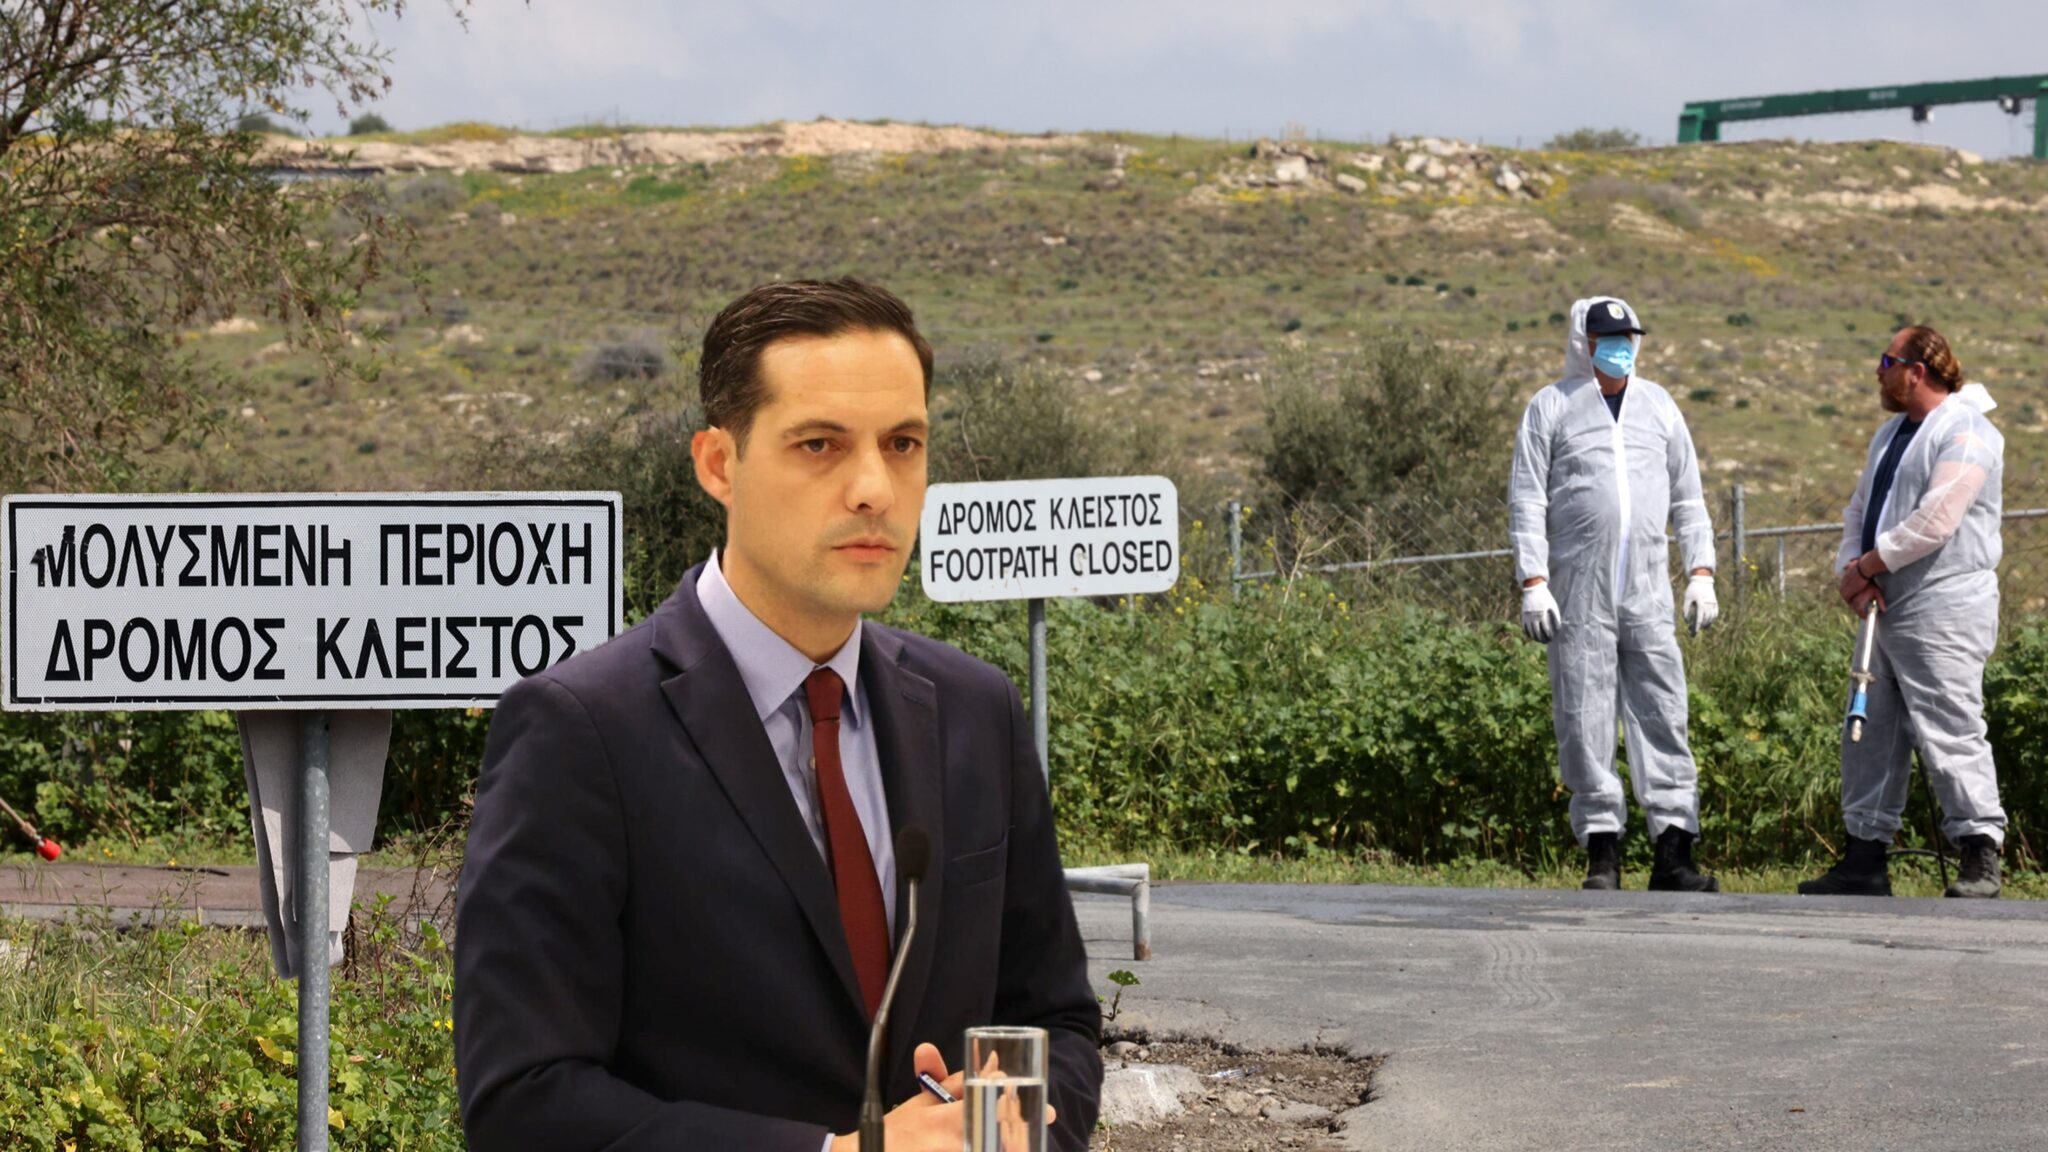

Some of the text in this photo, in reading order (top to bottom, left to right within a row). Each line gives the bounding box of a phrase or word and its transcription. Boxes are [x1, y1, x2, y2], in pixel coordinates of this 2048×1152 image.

[938, 493, 1161, 535] ΔΡΟΜΟΣ ΚΛΕΙΣΤΟΣ
[36, 522, 592, 588] ΜΟΛΥΣΜΕΝΗ ΠΕΡΙΟΧΗ
[931, 540, 1172, 582] FOOTPATH CLOSED
[44, 615, 584, 681] ΔΡΟΜΟΣ ΚΛΕΙΣΤΟΣ
